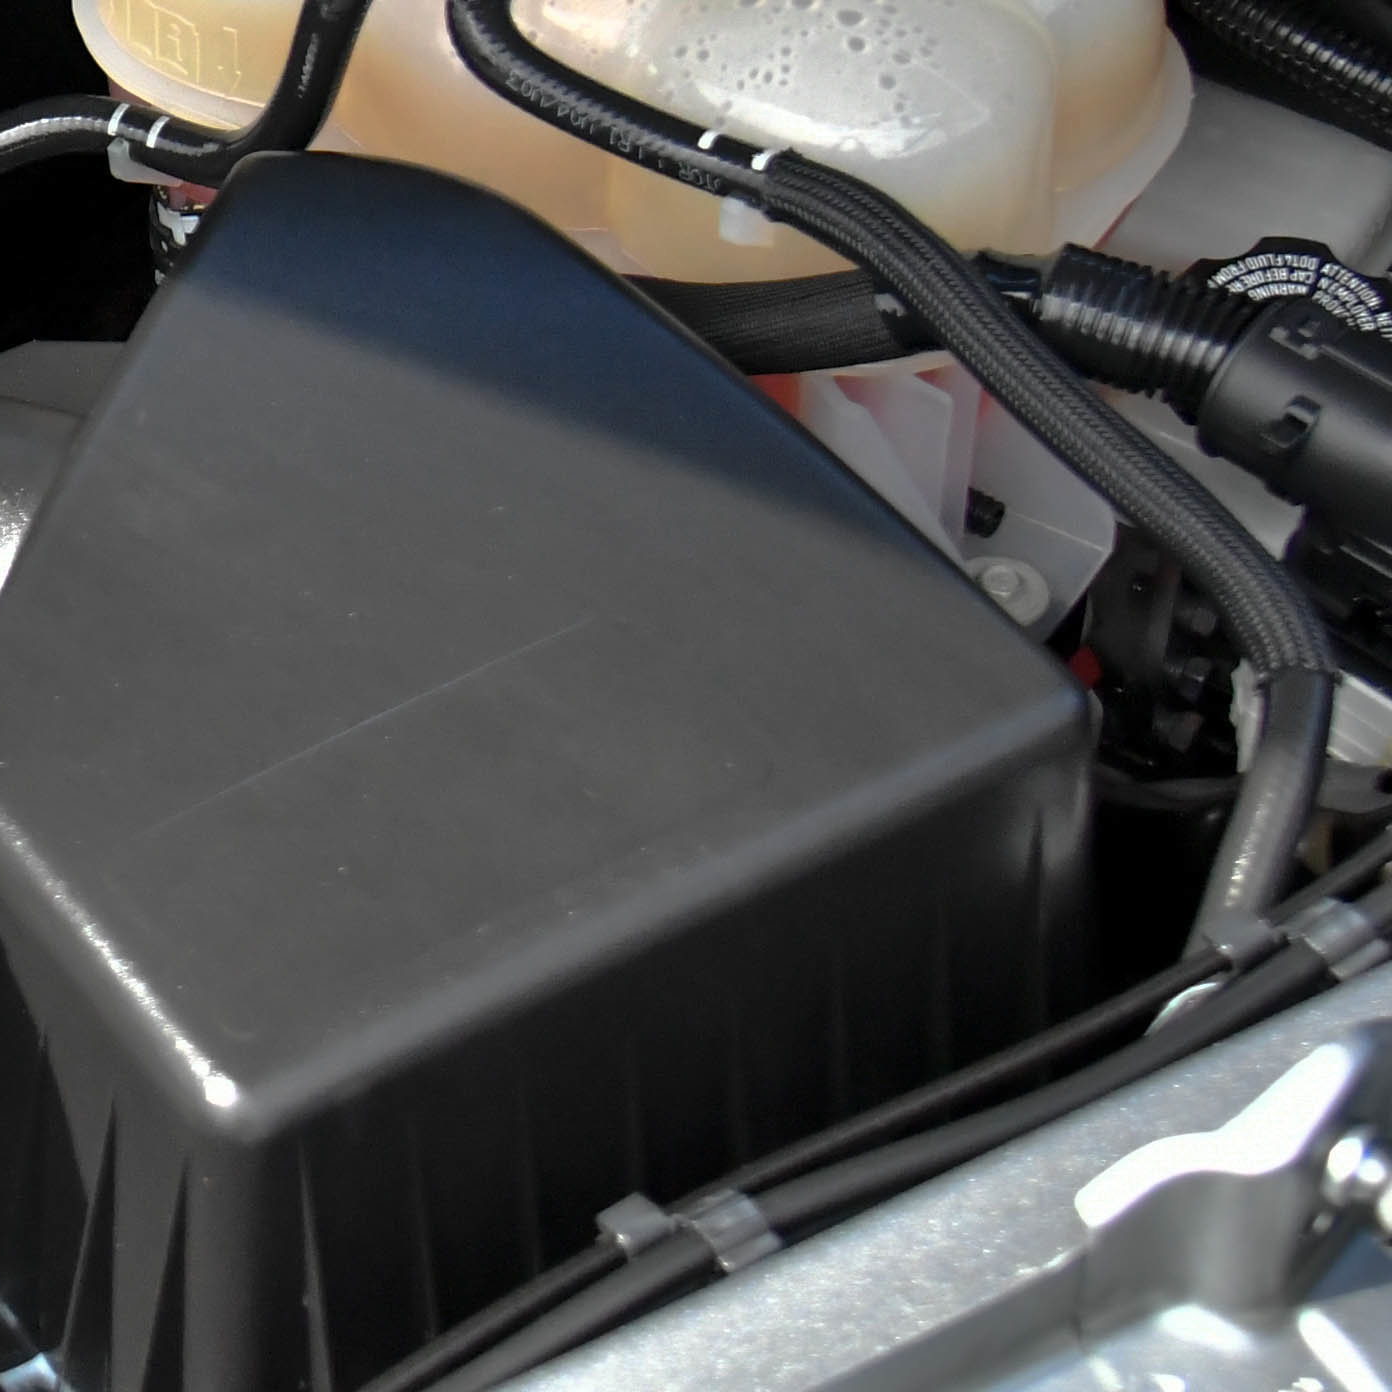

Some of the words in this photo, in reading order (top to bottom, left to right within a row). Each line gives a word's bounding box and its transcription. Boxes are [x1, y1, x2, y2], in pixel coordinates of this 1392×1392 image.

[1245, 253, 1285, 270] FLUID
[1213, 260, 1246, 285] FROM
[1240, 268, 1289, 287] BEFORE
[1289, 269, 1315, 284] CAP
[1247, 282, 1310, 301] WARNING
